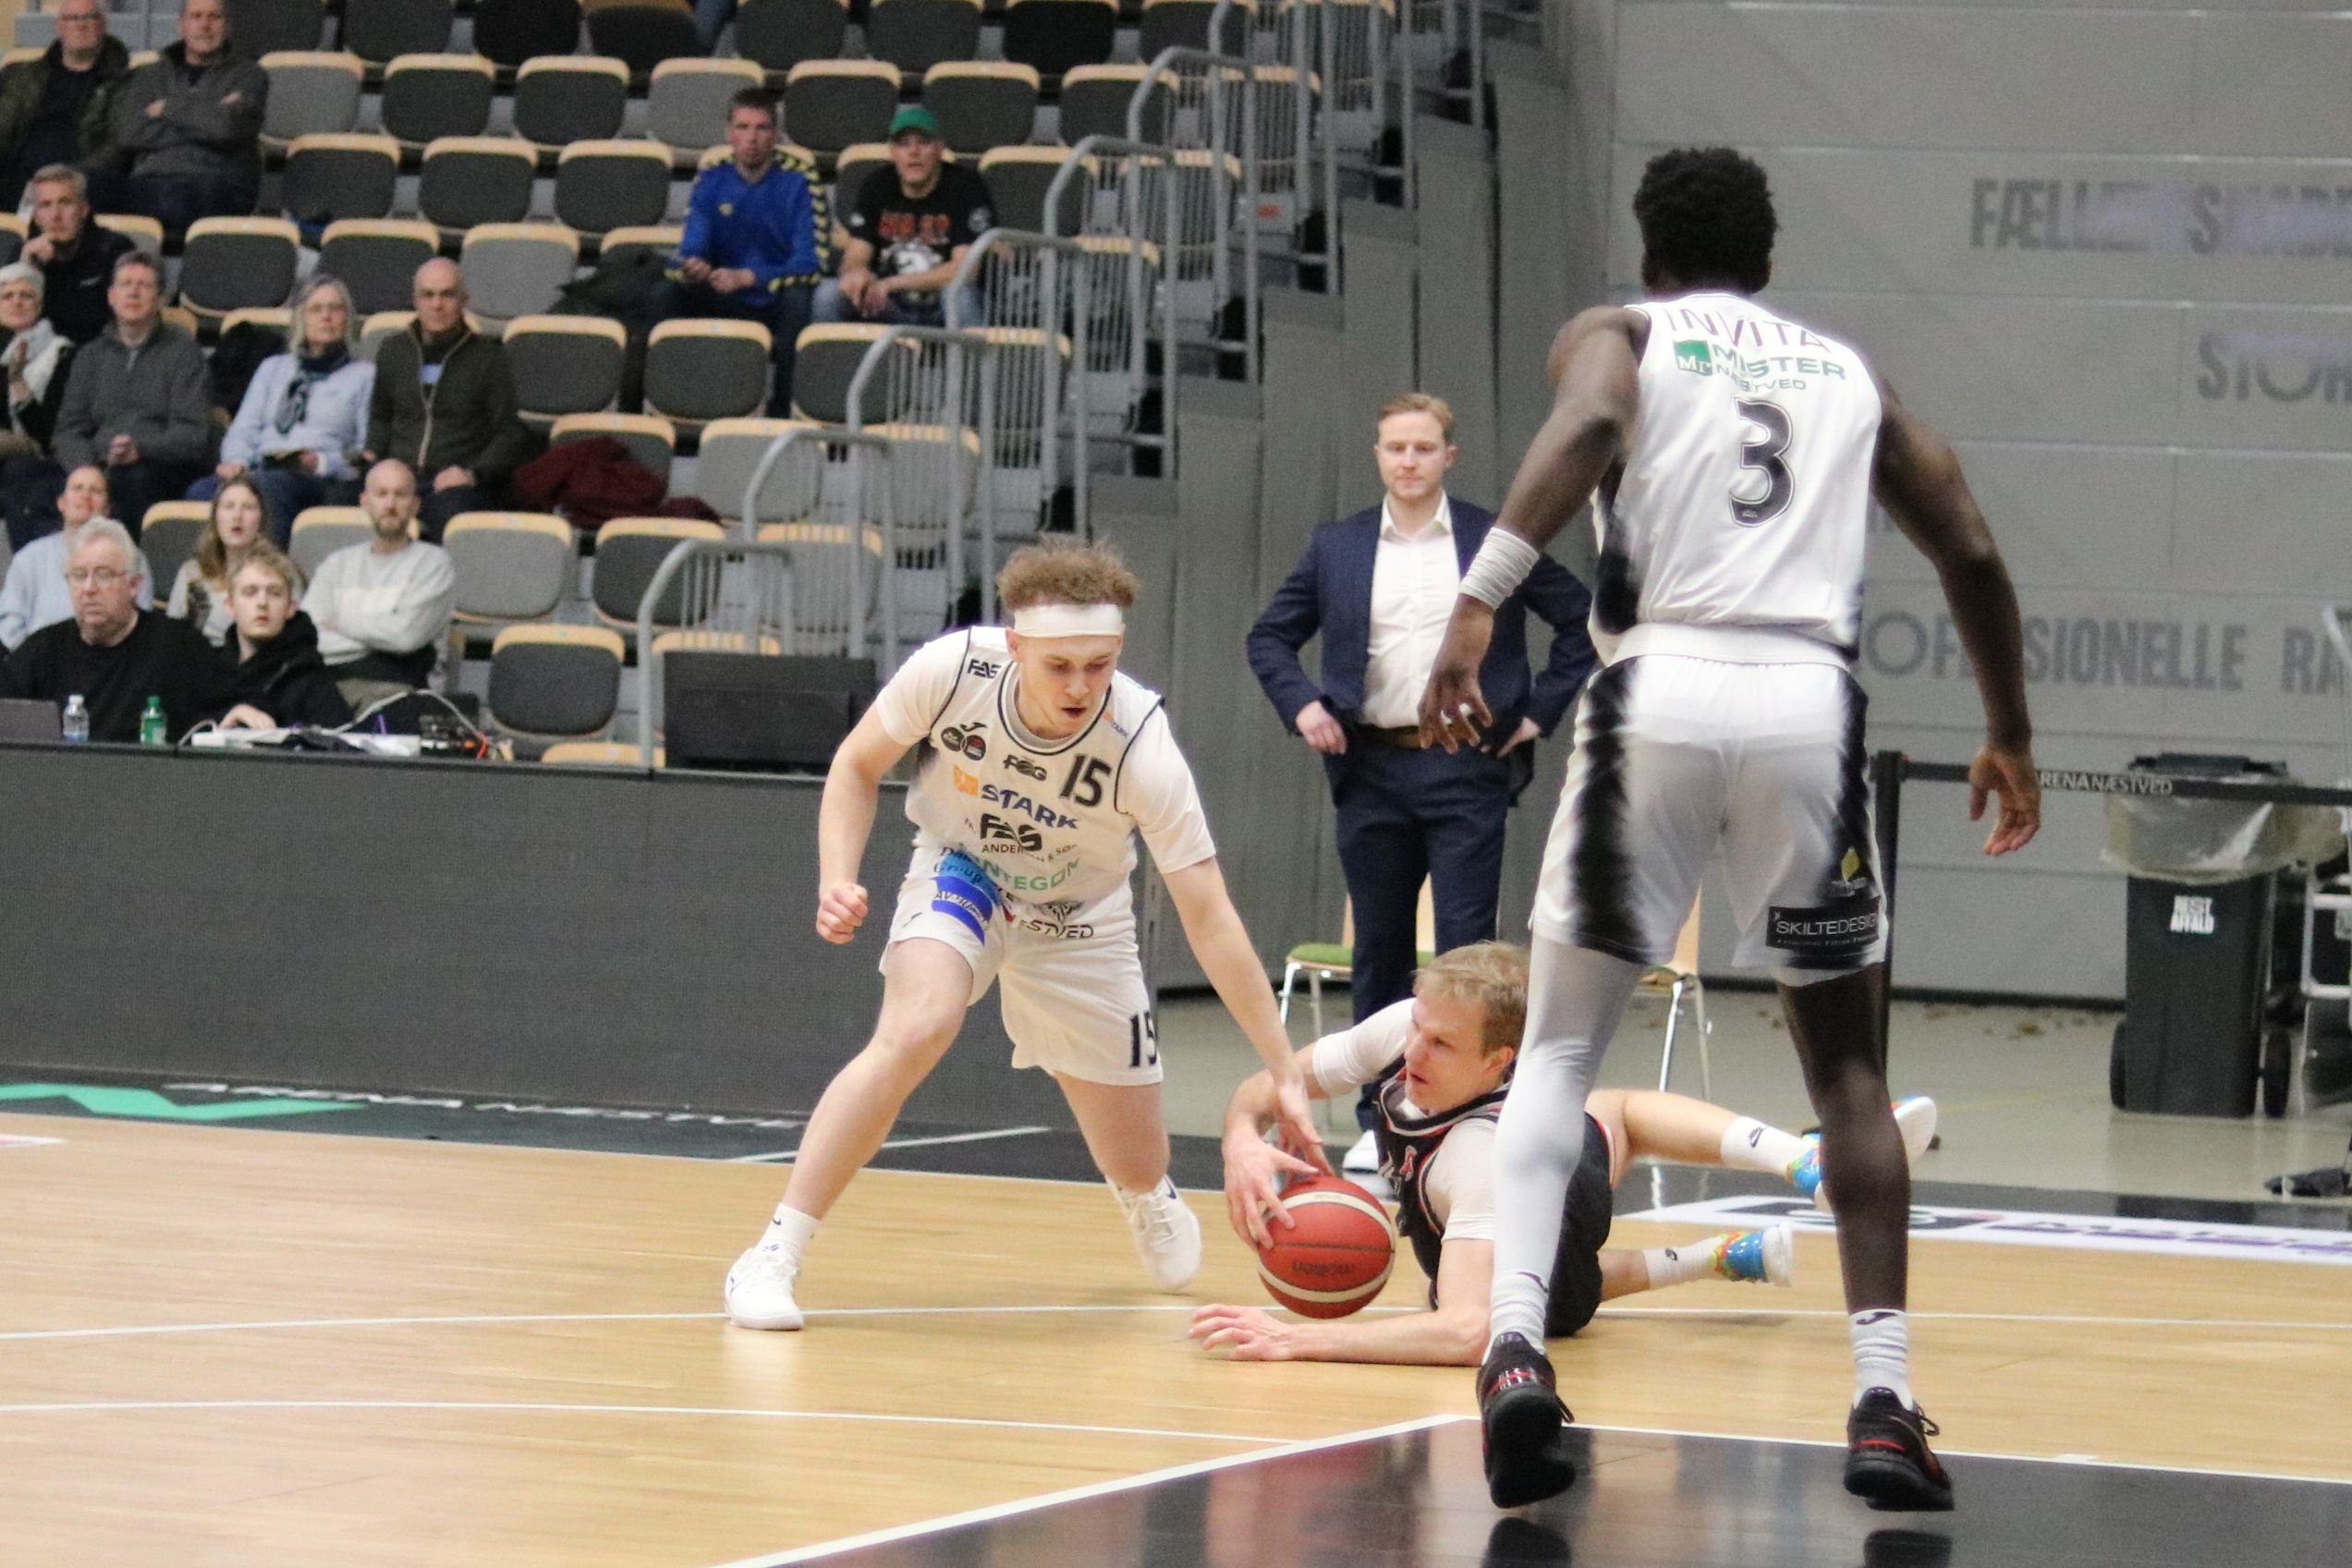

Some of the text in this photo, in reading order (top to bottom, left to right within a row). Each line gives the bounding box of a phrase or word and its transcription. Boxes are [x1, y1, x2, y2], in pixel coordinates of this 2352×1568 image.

[1663, 308, 1831, 353] INVITA
[1712, 343, 1847, 381] MISTER
[1729, 397, 1795, 528] 3
[1059, 753, 1112, 808] 15
[981, 784, 1079, 829] STARK
[1020, 918, 1095, 940] STVED
